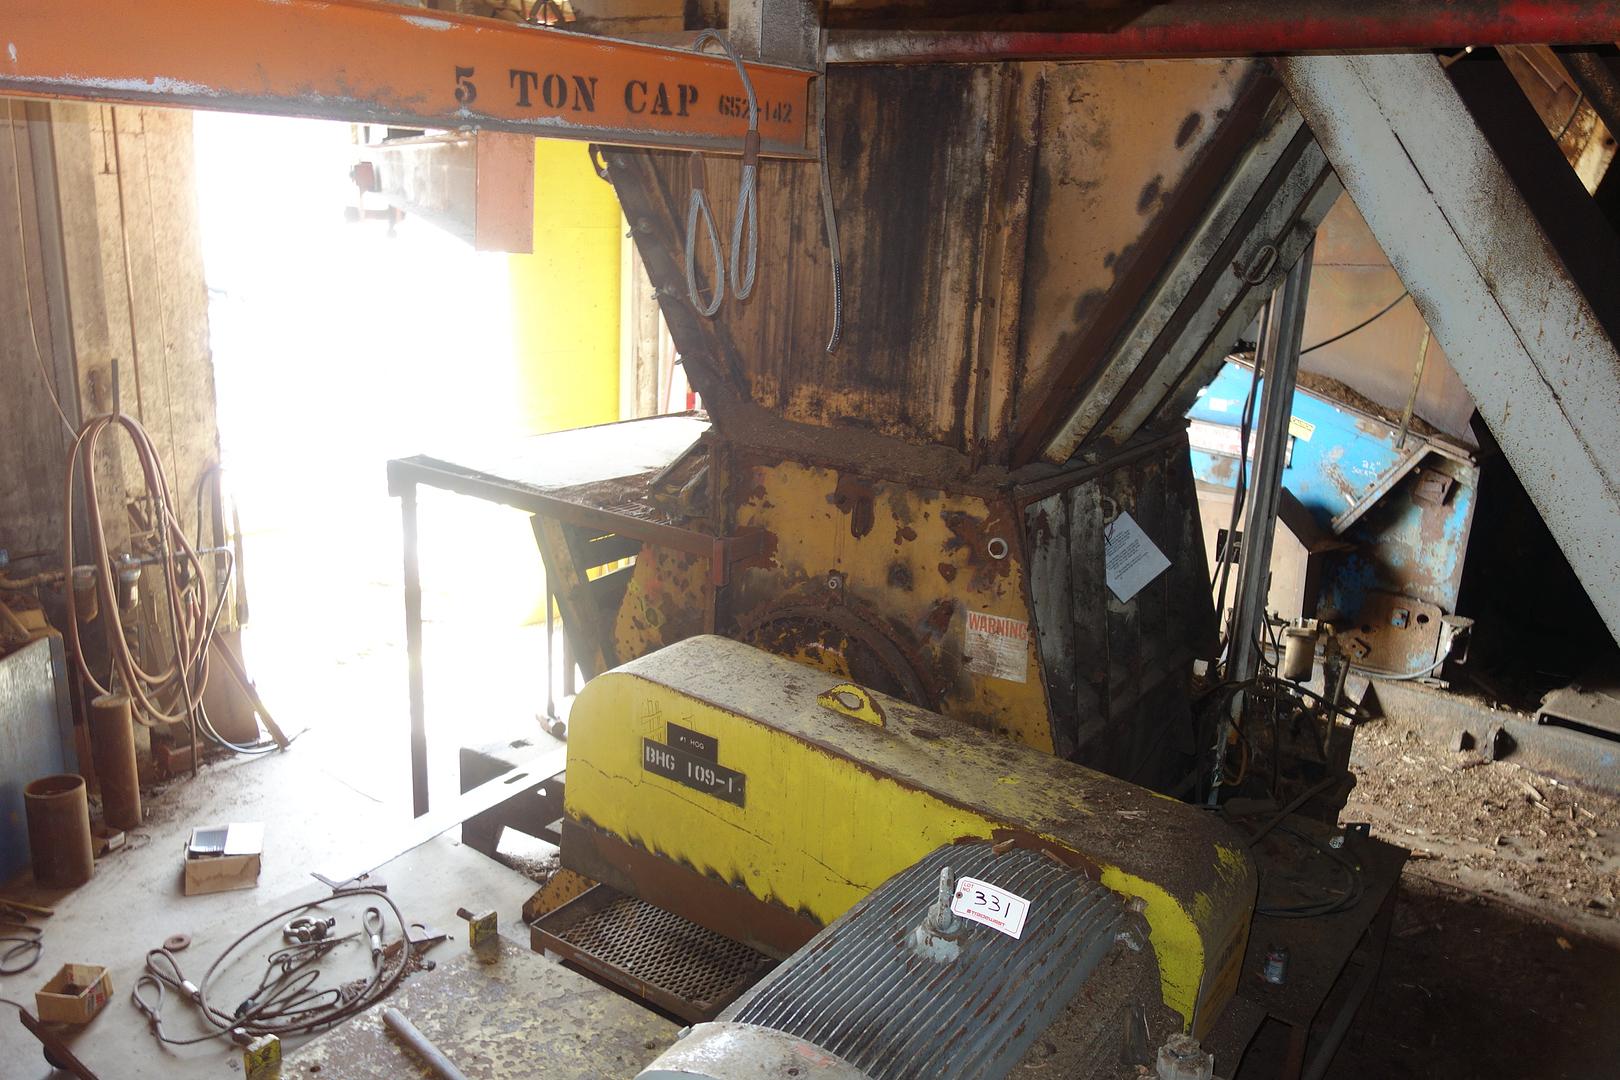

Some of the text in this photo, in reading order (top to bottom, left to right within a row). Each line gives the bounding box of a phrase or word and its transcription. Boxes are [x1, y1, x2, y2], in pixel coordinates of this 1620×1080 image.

[454, 65, 477, 105] 5
[509, 69, 598, 112] TON
[624, 80, 699, 117] CAP
[969, 613, 1027, 640] WARNING
[645, 745, 733, 793] BHG 109-1
[974, 891, 1011, 918] 331
